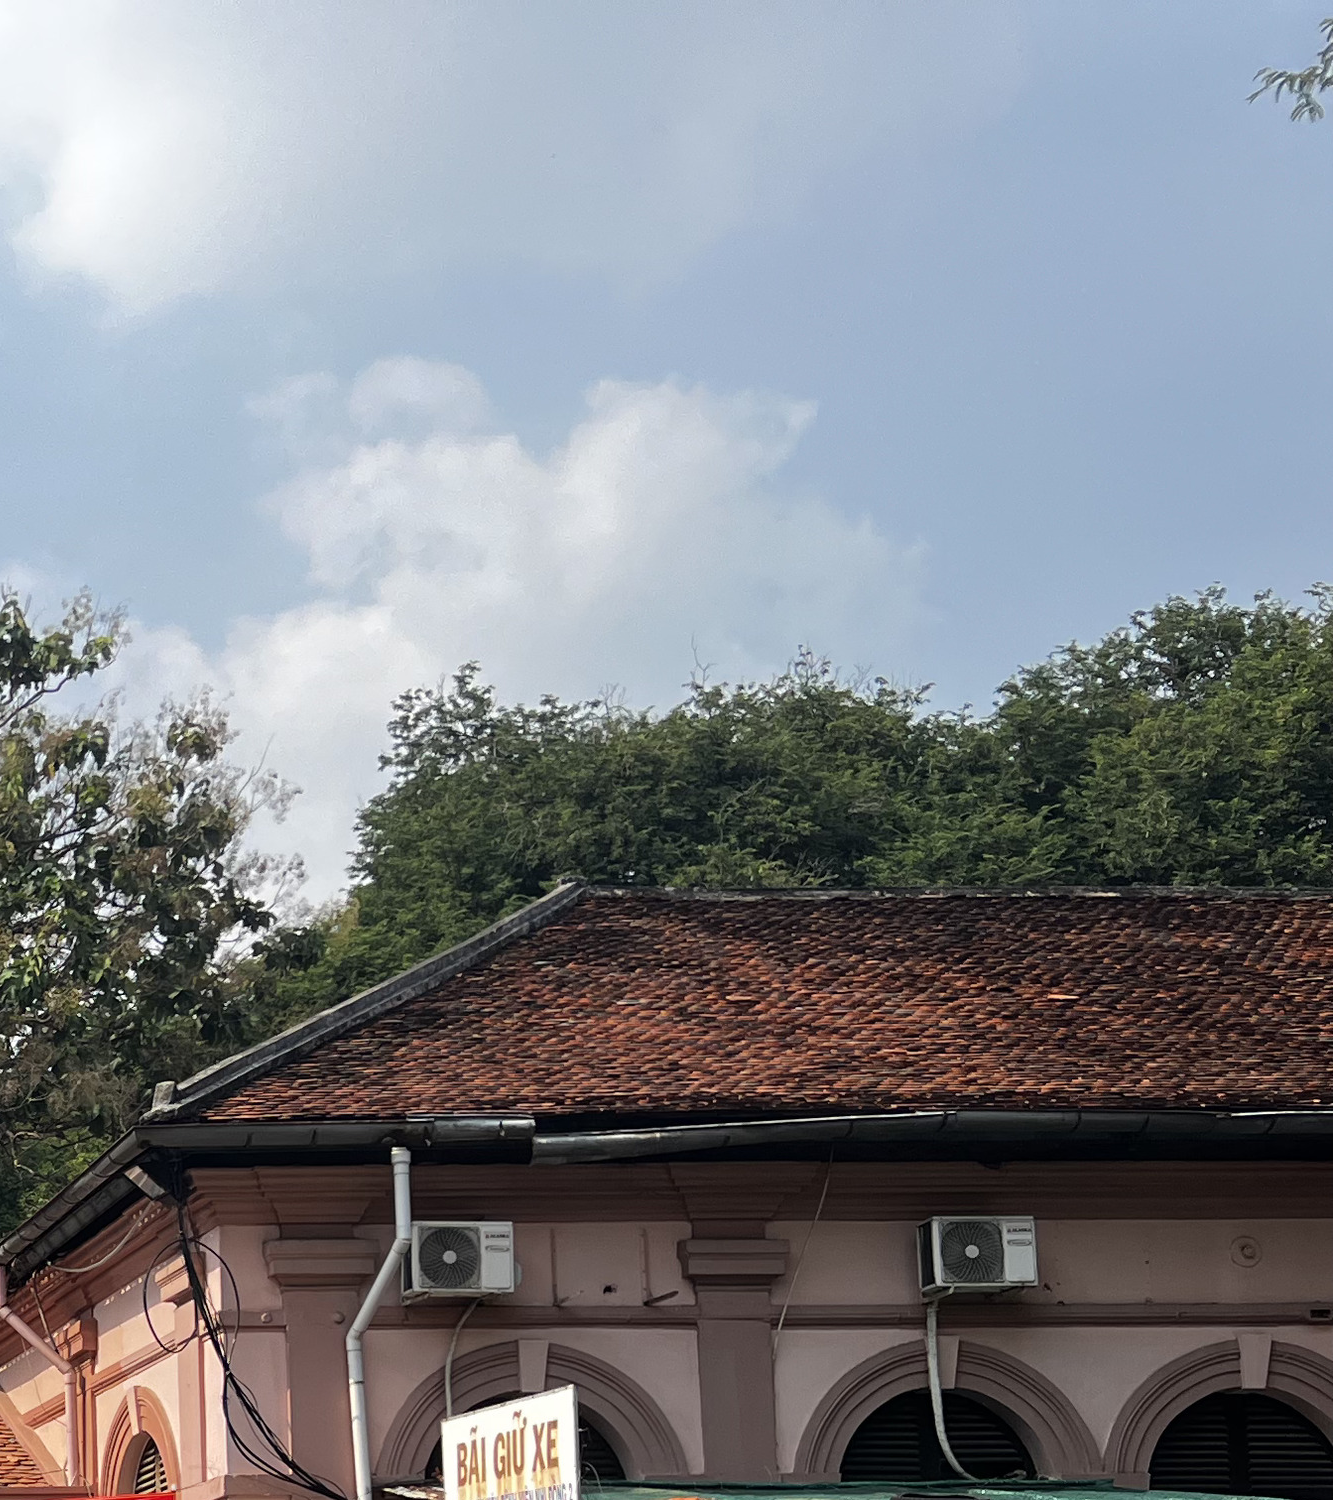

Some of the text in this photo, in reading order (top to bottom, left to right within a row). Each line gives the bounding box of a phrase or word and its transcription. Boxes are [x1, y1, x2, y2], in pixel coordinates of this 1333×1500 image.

[457, 1410, 559, 1487] BÃI GIỮ XE
